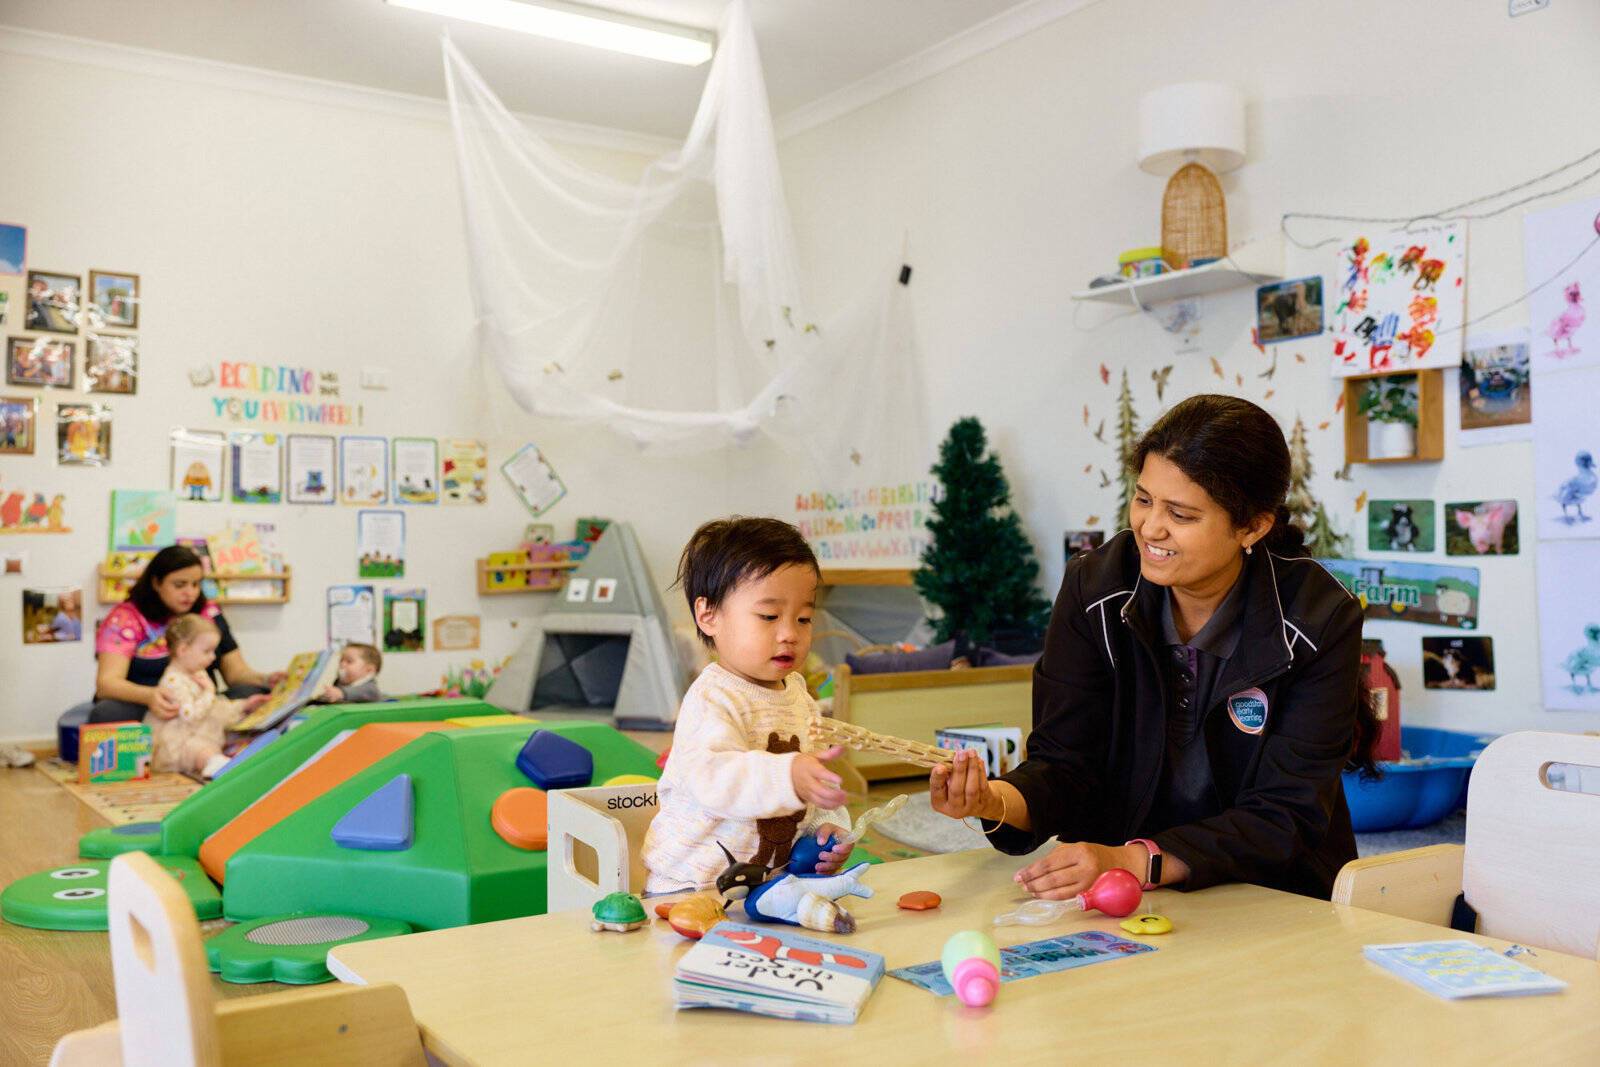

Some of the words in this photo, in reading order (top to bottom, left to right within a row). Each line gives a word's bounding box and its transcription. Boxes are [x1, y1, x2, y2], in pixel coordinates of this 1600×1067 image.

[211, 396, 259, 422] YOU
[1353, 578, 1421, 606] Farm
[715, 959, 824, 991] Under
